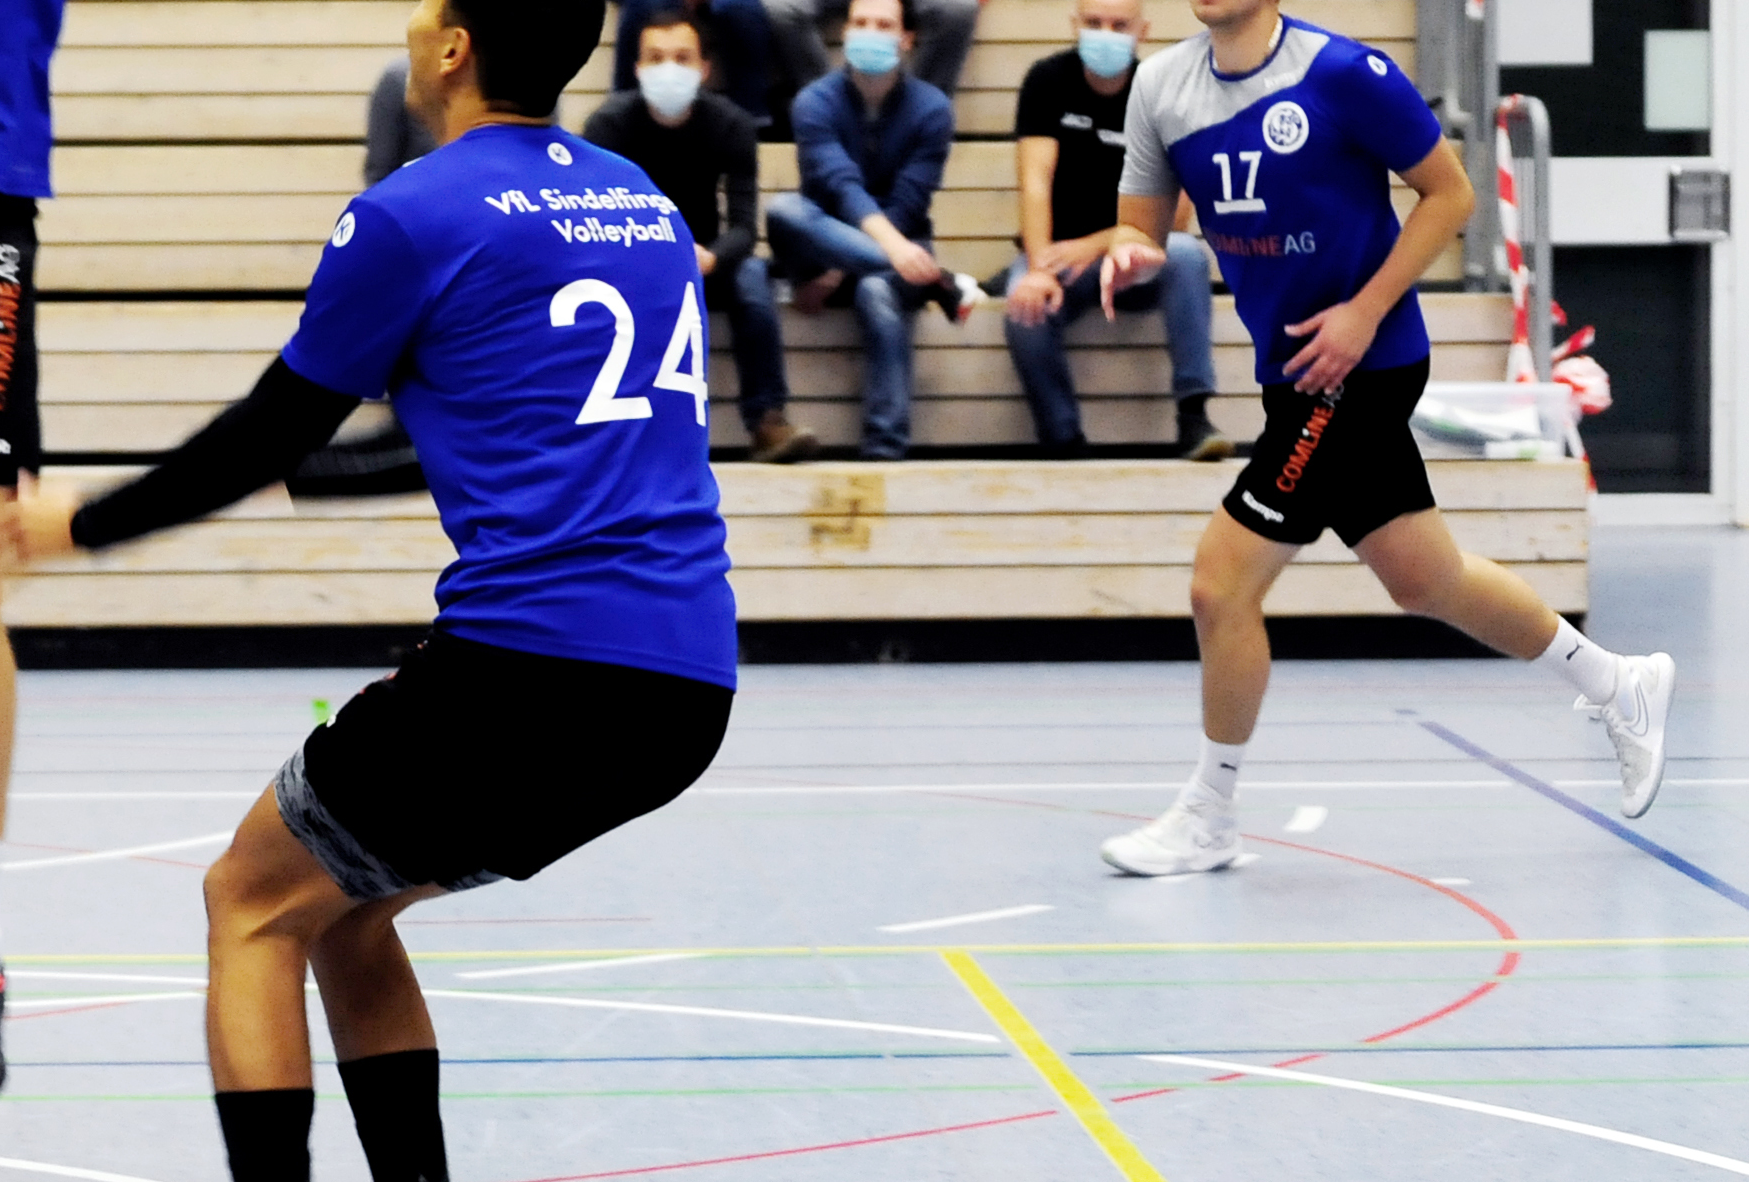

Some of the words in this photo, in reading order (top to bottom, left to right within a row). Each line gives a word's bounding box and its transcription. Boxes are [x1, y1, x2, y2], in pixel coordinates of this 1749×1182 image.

[1211, 150, 1264, 203] 17
[484, 189, 541, 215] VfL
[539, 186, 678, 215] Sindelfinge
[551, 216, 677, 248] Volleyball
[550, 278, 708, 427] 24
